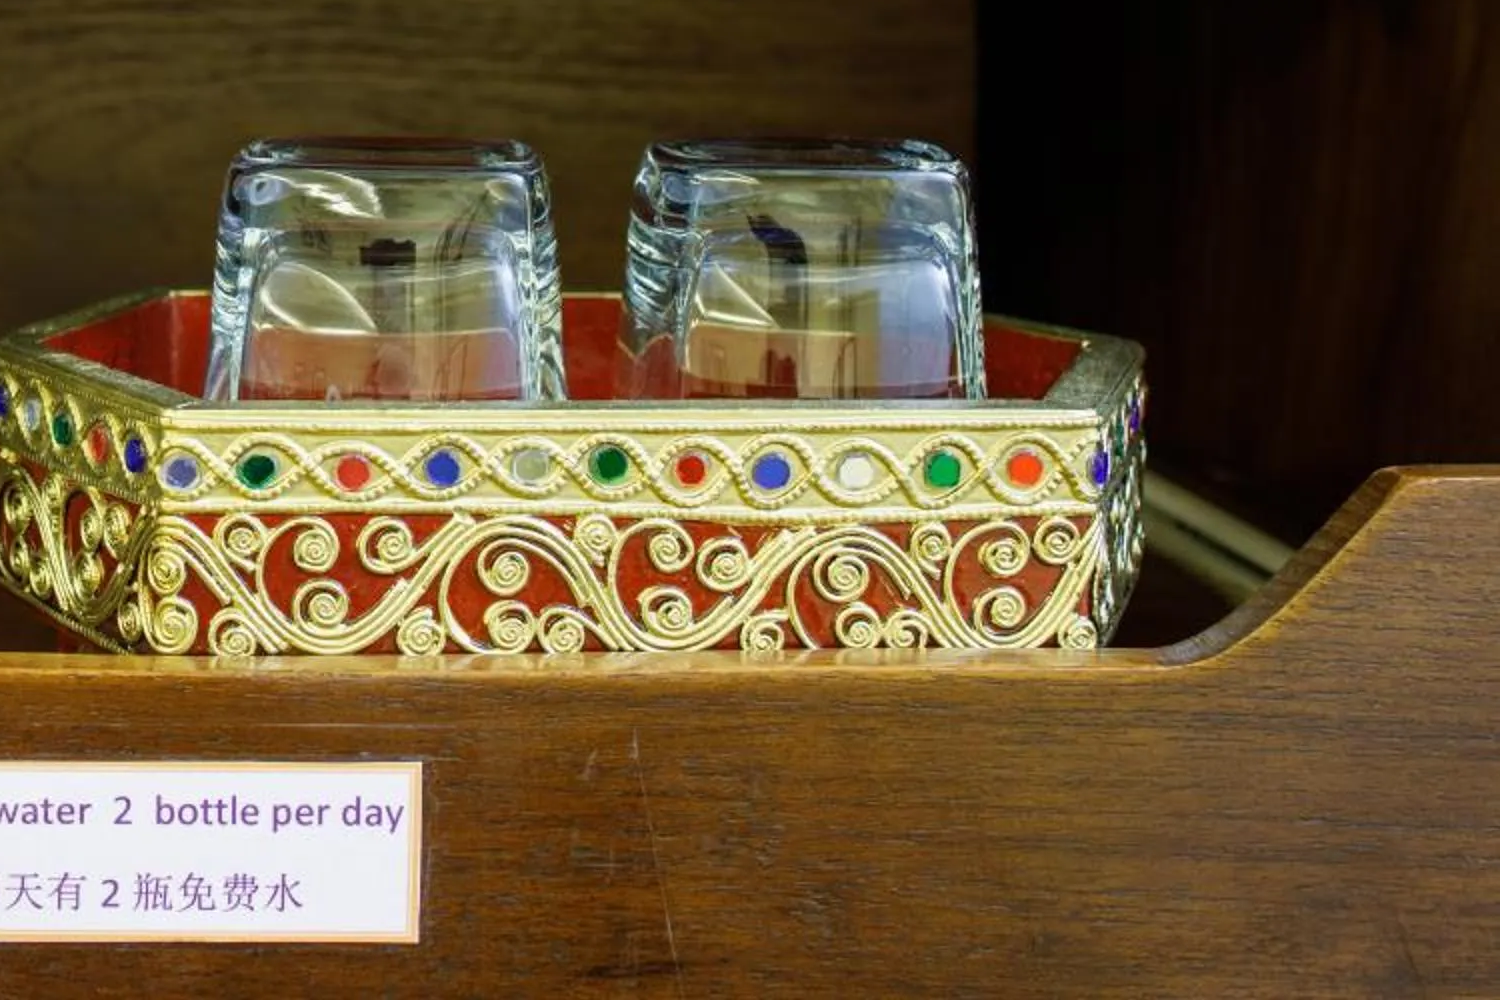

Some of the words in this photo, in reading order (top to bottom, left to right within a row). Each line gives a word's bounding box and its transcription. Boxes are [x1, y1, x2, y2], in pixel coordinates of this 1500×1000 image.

[113, 796, 133, 825] 2
[155, 794, 259, 826] bottle
[271, 800, 330, 832] per
[341, 796, 404, 833] day
[101, 878, 120, 908] 2
[133, 872, 304, 912] 瓶免费水
